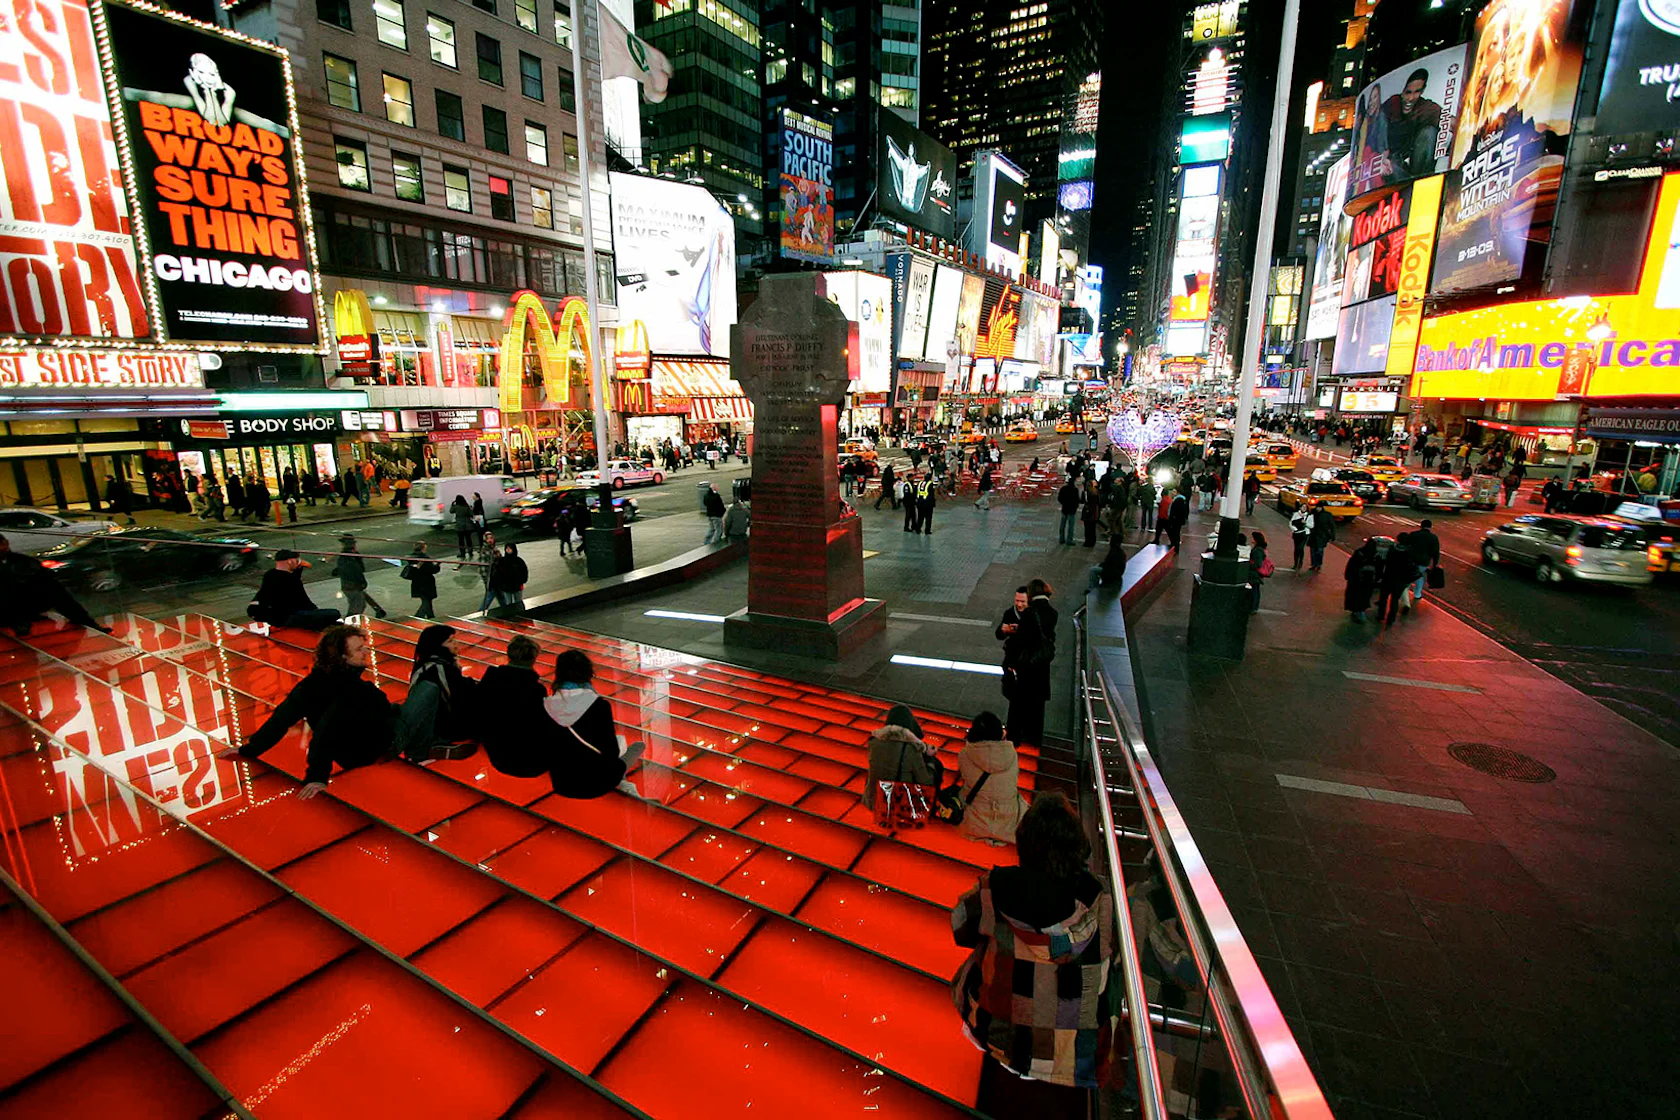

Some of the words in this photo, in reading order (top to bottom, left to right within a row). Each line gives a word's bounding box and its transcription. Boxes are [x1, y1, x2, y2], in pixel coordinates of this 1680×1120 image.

[139, 101, 285, 156] BROAD
[1434, 77, 1456, 160] SOUTHPOLE
[144, 130, 289, 186] WAY'S
[784, 129, 833, 165] SOUTH
[1461, 133, 1520, 187] RACE
[783, 150, 832, 186] PACIFIC
[153, 164, 295, 219] SURE
[1456, 189, 1512, 222] MOUNTAIN
[1460, 166, 1514, 210] WITCH
[157, 201, 300, 261] THING
[618, 203, 705, 226] MAXIMUM
[619, 224, 670, 241] LIVES
[1352, 191, 1404, 250] Kodak
[153, 254, 313, 294] CHICAGO
[913, 270, 928, 293] WAR
[1396, 232, 1431, 326] Kodak
[795, 342, 824, 352] DUFFY
[37, 352, 109, 383] SIDE
[117, 353, 187, 383] STORY
[240, 418, 289, 434] BODY
[1589, 417, 1635, 429] AMERICAN
[1635, 419, 1665, 431] EAGLE
